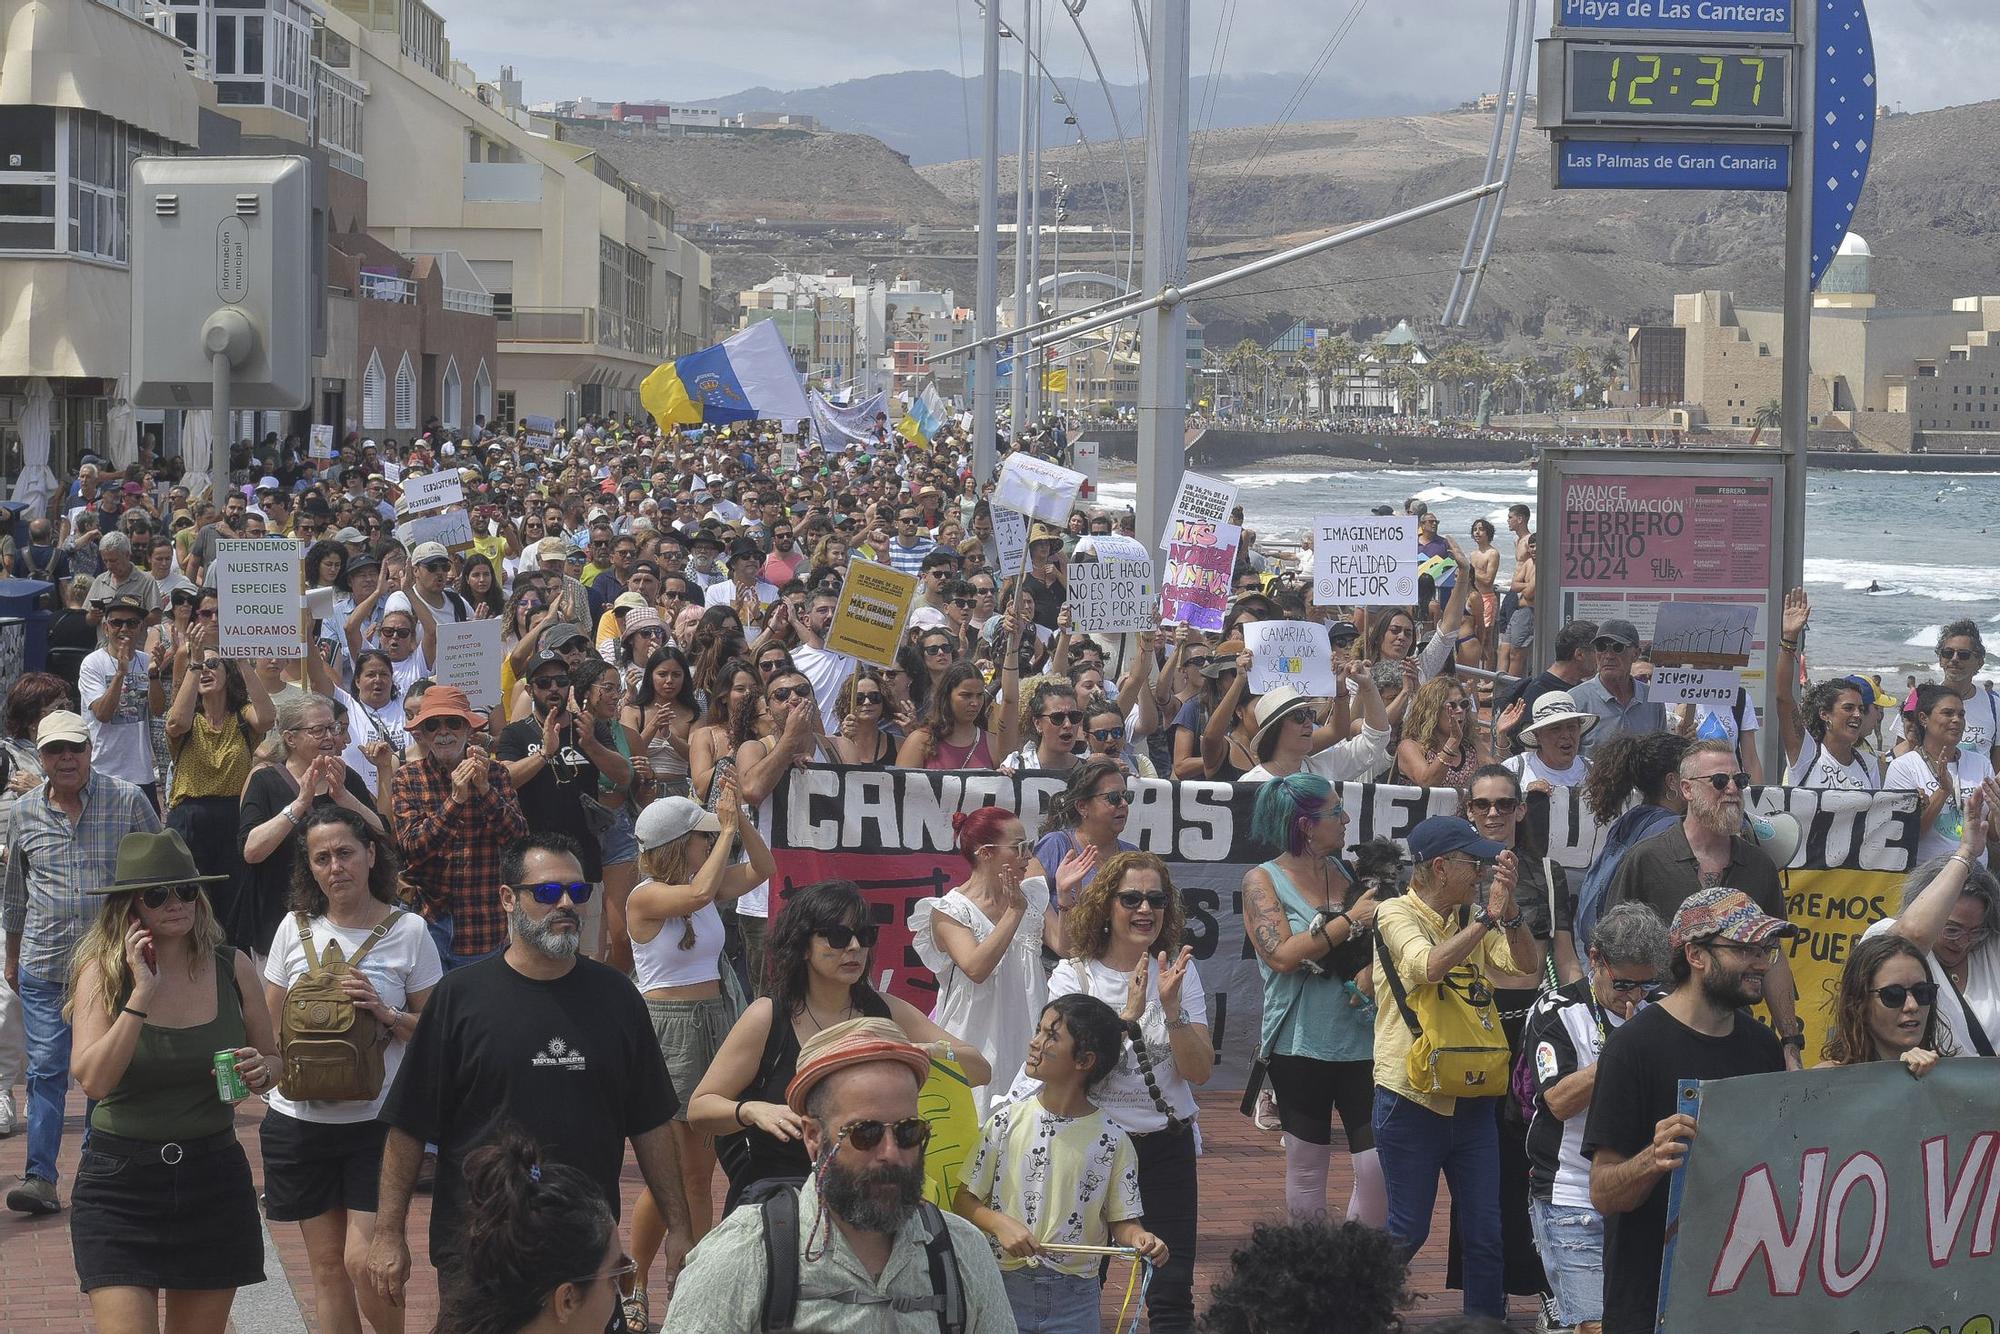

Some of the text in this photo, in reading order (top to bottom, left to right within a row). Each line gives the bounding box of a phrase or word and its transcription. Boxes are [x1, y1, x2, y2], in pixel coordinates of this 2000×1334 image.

[1566, 0, 1785, 23] Playa de Las Canteras
[1607, 56, 1766, 107] 12:37
[1567, 153, 1777, 171] Las Palmas de Gran Canaria
[222, 231, 230, 290] información
[234, 242, 242, 290] municipal
[1566, 485, 1628, 500] AVANCE
[1718, 487, 1746, 495] FEBRERO
[1179, 501, 1189, 510] DE
[1189, 503, 1223, 520] POBREZA
[1204, 501, 1225, 512] RIESGO
[1566, 496, 1684, 514] PROGRAMACIÓN
[1566, 511, 1684, 537] FEBRERO
[1323, 527, 1403, 541] IMAGINEMOS
[218, 541, 297, 551] DEFENDEMOS
[1352, 543, 1368, 552] UNA
[1565, 533, 1646, 559] JUNIO
[227, 563, 289, 572] NUESTRAS
[1069, 561, 1151, 581] LO QUE HAGO
[1331, 555, 1397, 574] REALIDAD
[1566, 556, 1629, 580] 2024
[231, 584, 287, 593] ESPECIES
[1069, 581, 1136, 600] NO ES POR
[1338, 576, 1389, 597] MEJOR
[236, 605, 284, 615] PORQUE
[866, 604, 897, 618] GRANDE
[1091, 601, 1108, 618] ES
[1112, 600, 1137, 617] POR
[1140, 600, 1153, 616] EL
[854, 614, 870, 623] GRAN
[1081, 618, 1105, 631] 922
[1133, 615, 1153, 630] 928
[224, 625, 297, 635] VALORAMOS
[1261, 627, 1314, 643] CANARIAS
[220, 646, 303, 656] NUESTRA ISLA
[447, 642, 482, 651] PROYECTOS
[1260, 644, 1271, 656] NO
[1680, 688, 1732, 699] COLAPSO
[787, 769, 1234, 862] CANRAS
[1785, 893, 1888, 924] REMOS
[1707, 1147, 1889, 1298] NO
